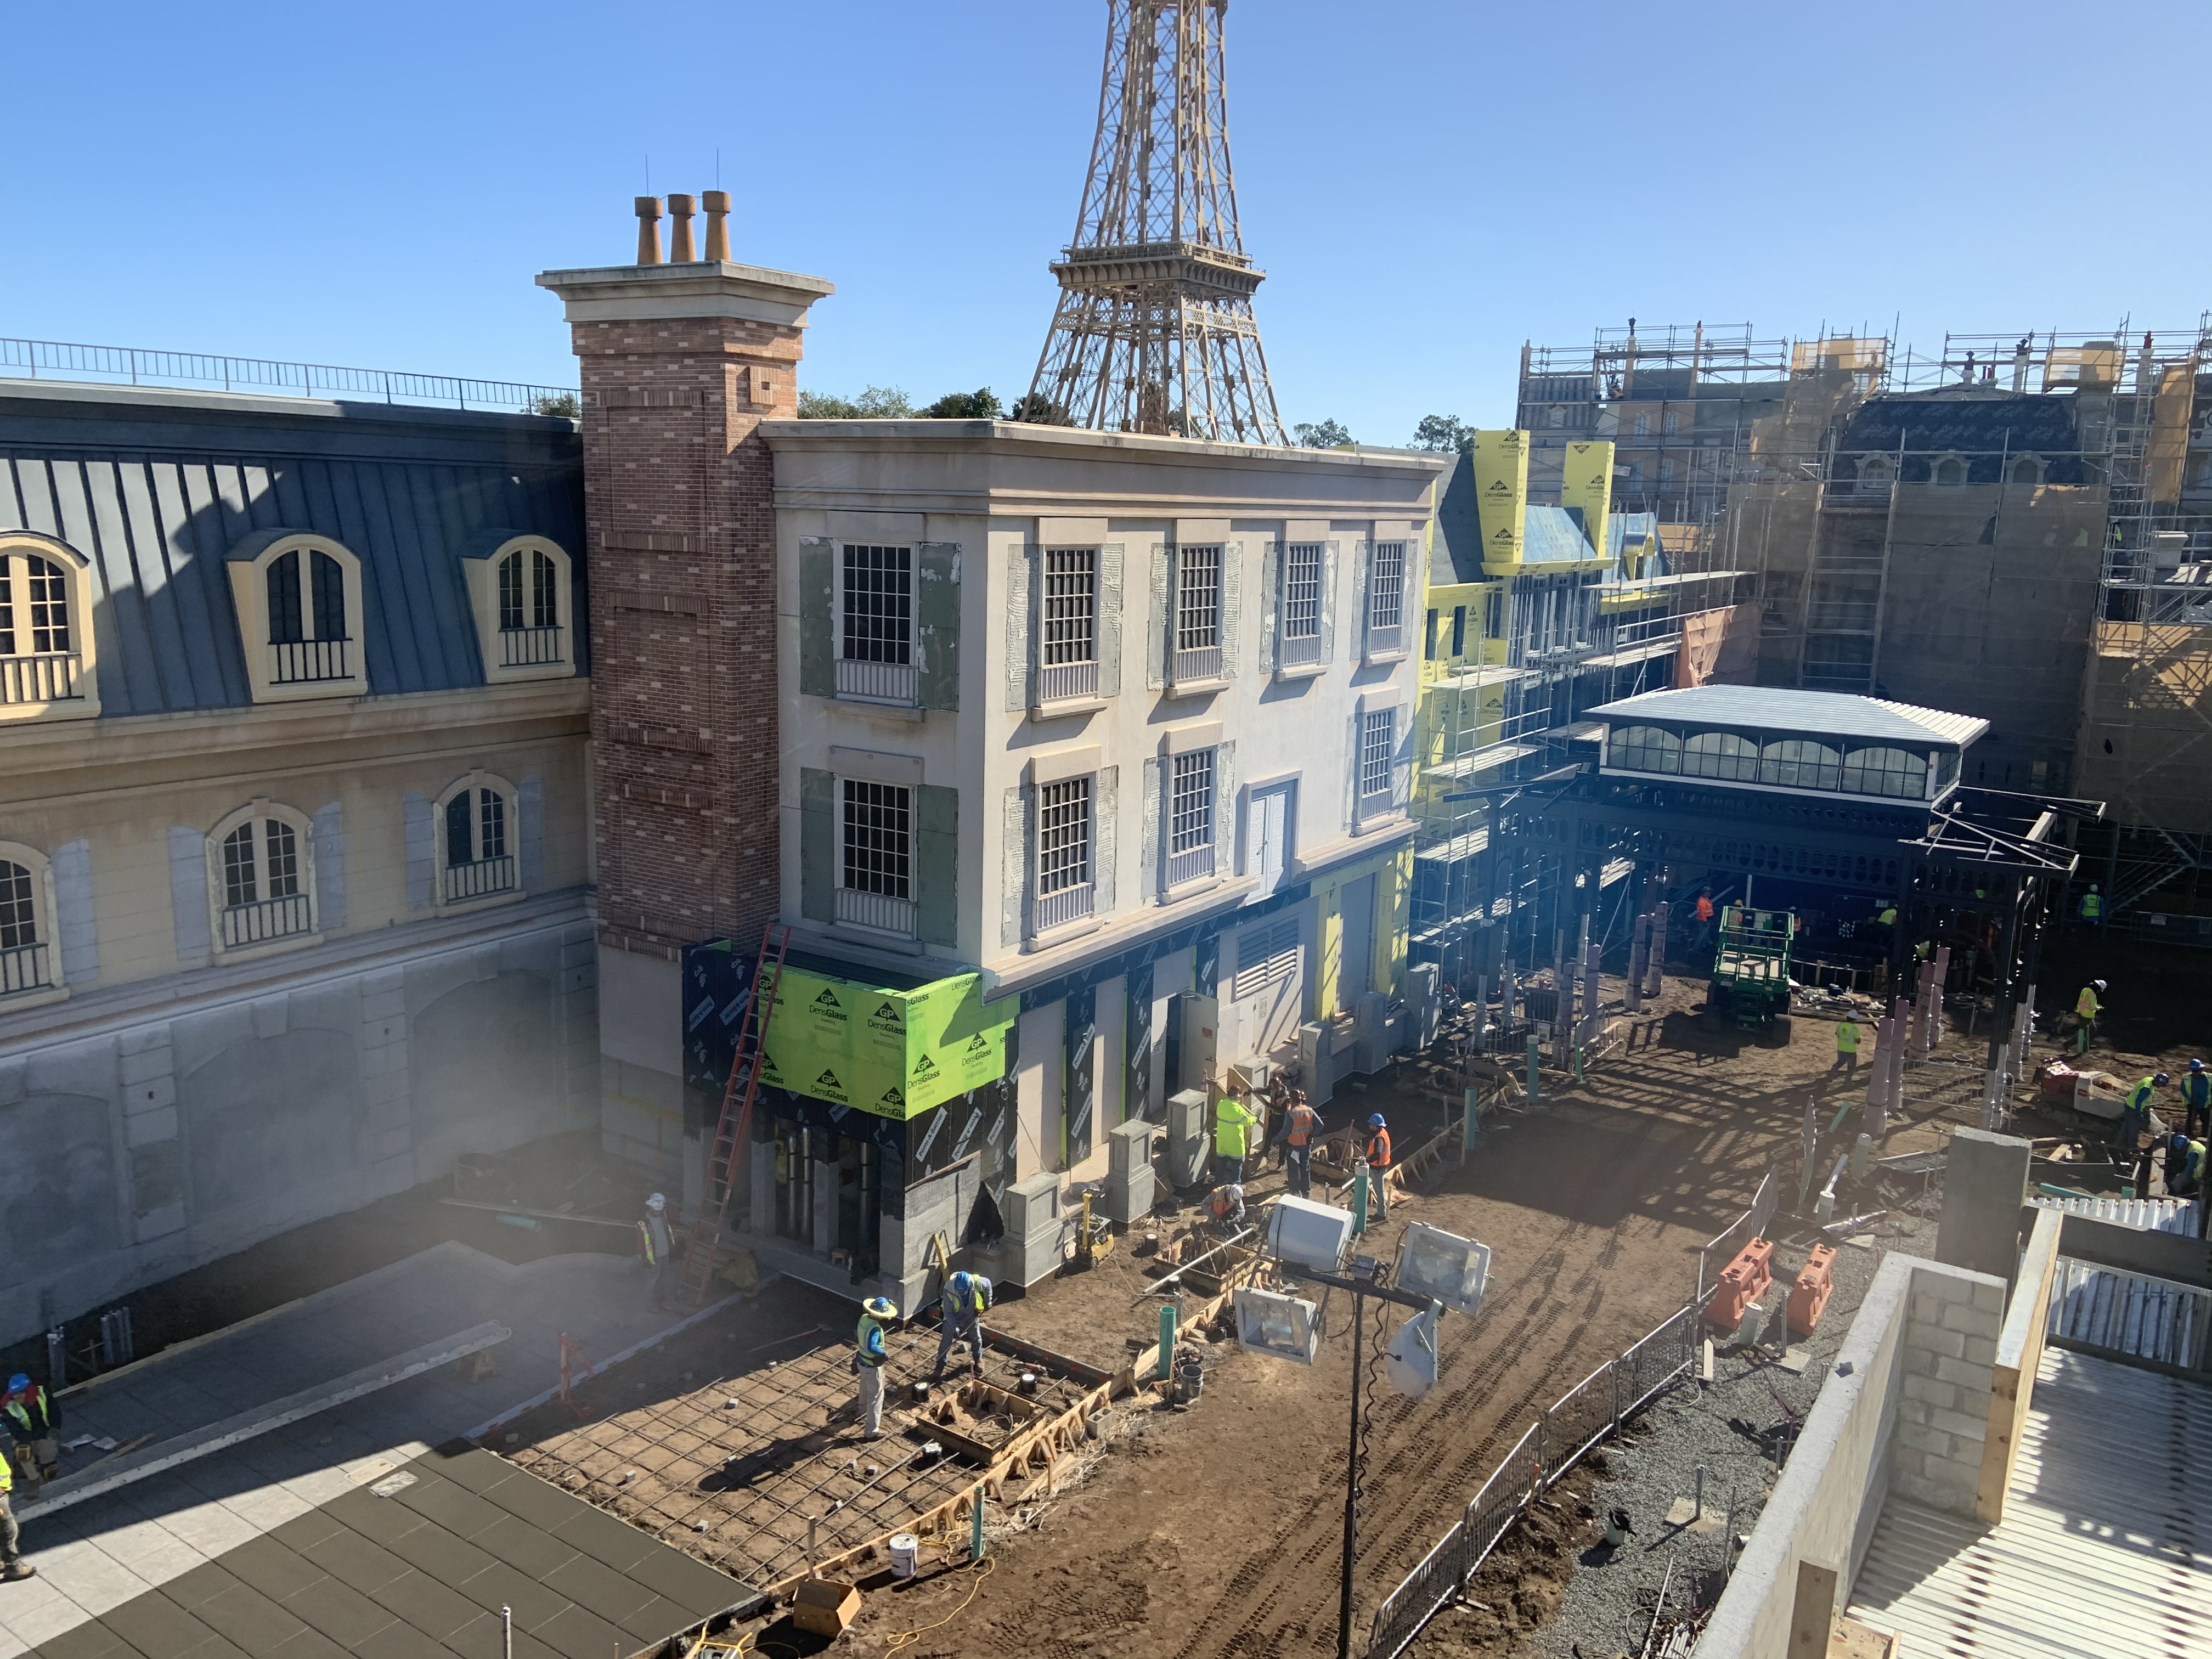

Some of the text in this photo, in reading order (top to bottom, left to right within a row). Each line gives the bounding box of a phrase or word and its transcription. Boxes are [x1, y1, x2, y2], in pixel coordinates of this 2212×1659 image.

[821, 994, 834, 1003] GP
[809, 1005, 848, 1021] DensGlass
[879, 1008, 894, 1018] GP
[867, 1019, 906, 1036] DensGlass
[971, 1039, 983, 1048] GP
[917, 1059, 930, 1071] GP
[962, 1048, 992, 1066] DensGlass
[822, 1075, 836, 1085] GP
[907, 1070, 940, 1090] DensGlass
[810, 1085, 849, 1102] DensGlass
[887, 1093, 901, 1103] GP
[875, 1103, 905, 1119] DensGla
[918, 1113, 944, 1157] Perm-A-Barrier
